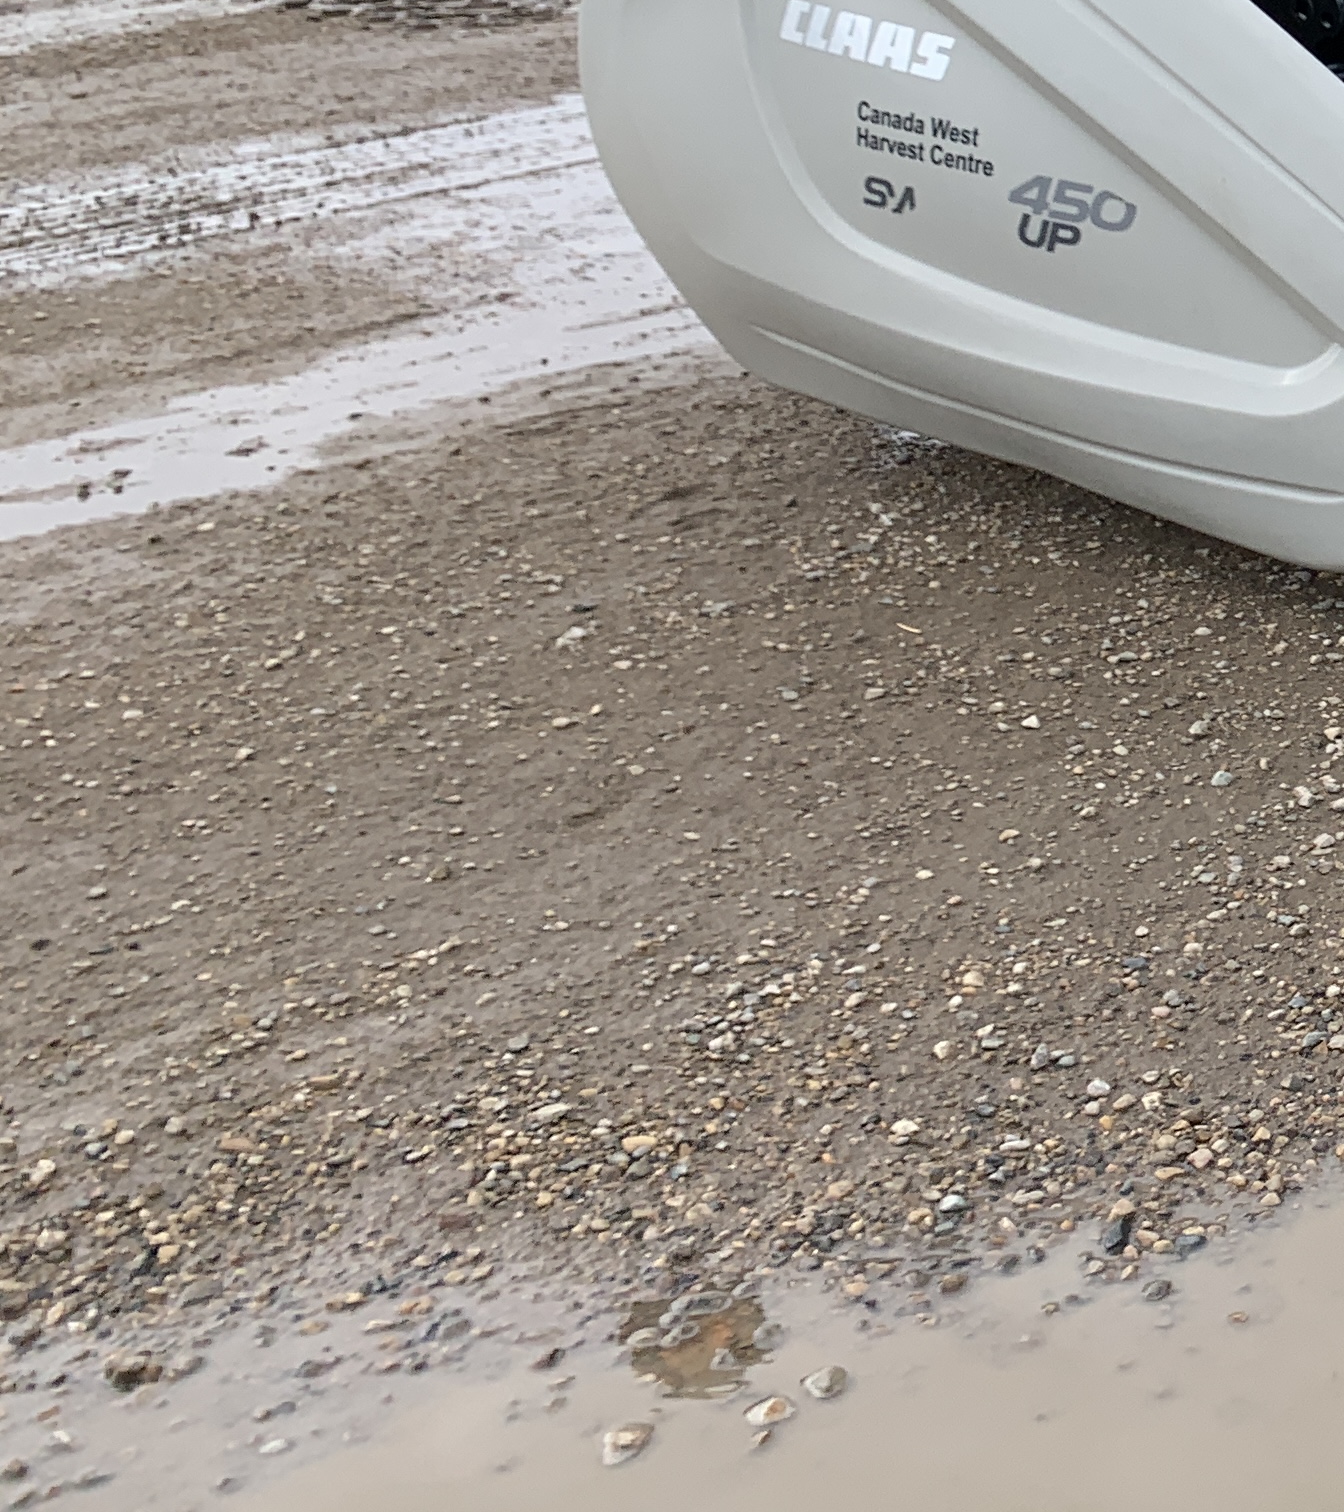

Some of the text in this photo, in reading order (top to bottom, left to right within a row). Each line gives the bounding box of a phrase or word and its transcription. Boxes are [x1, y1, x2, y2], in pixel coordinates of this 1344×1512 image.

[857, 100, 979, 148] Canada West
[856, 126, 995, 177] Harvest Centre
[1007, 174, 1138, 232] 450
[1018, 212, 1083, 254] UP
